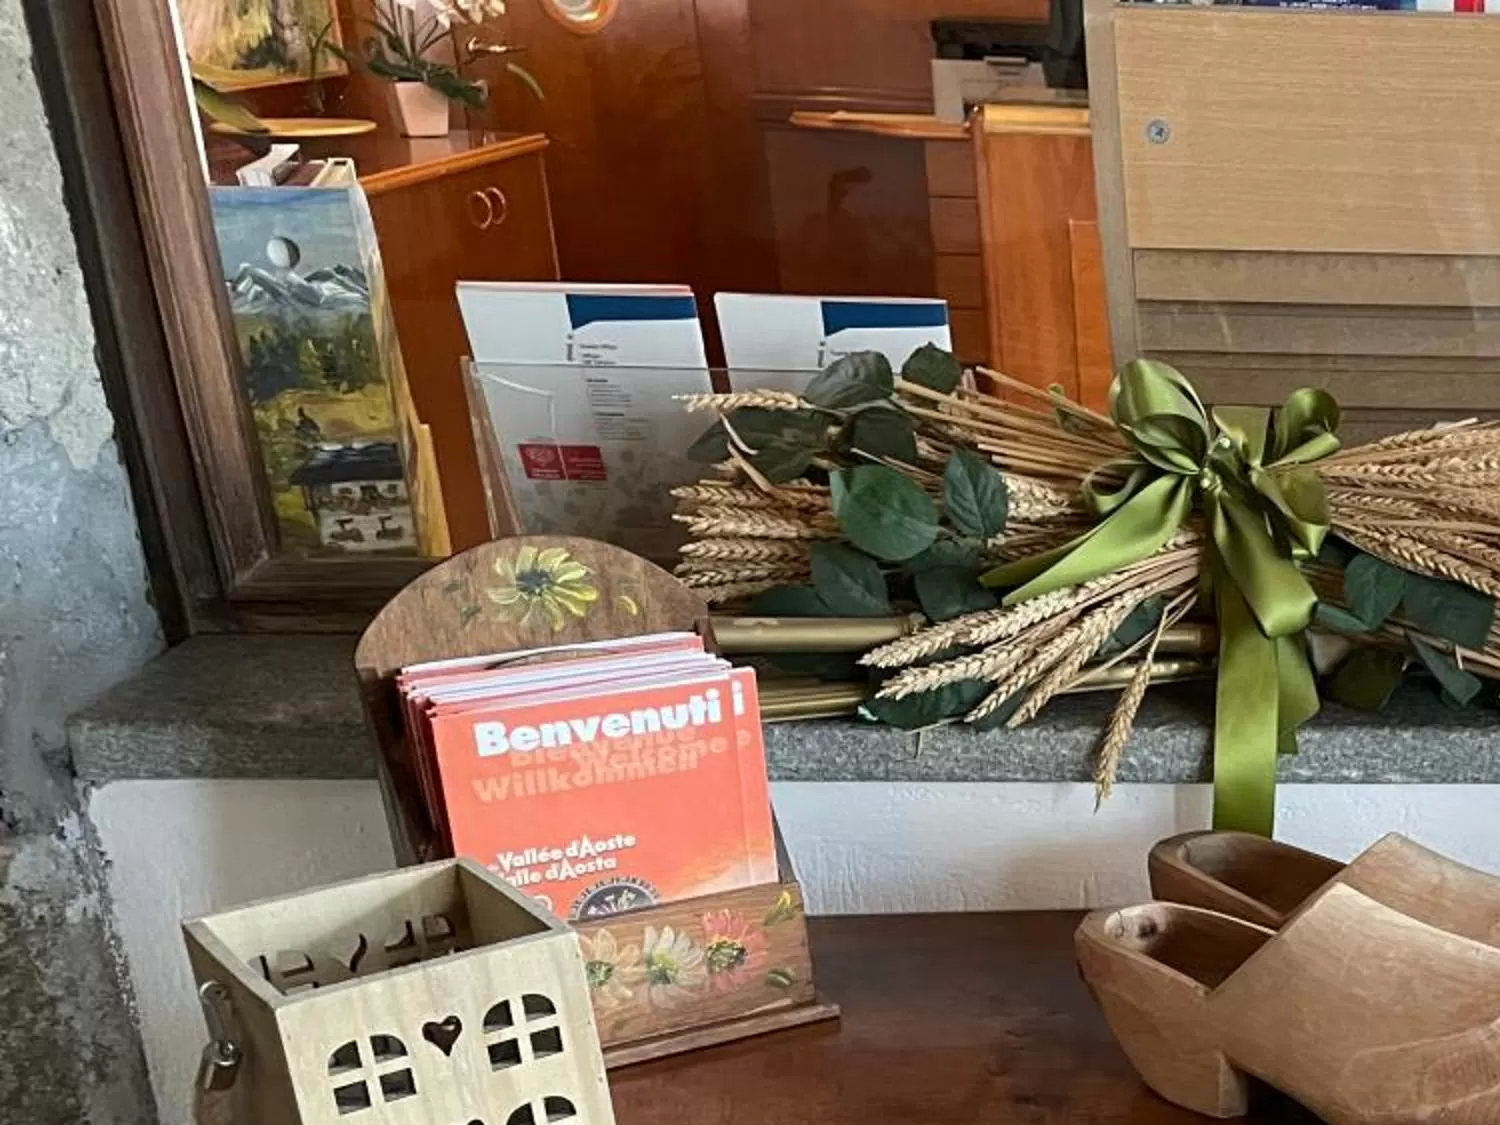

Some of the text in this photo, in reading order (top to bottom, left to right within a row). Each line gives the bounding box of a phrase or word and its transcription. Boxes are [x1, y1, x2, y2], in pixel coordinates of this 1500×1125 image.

[473, 688, 721, 757] Benvenuti
[496, 846, 563, 872] Vallée
[498, 869, 541, 888] alle
